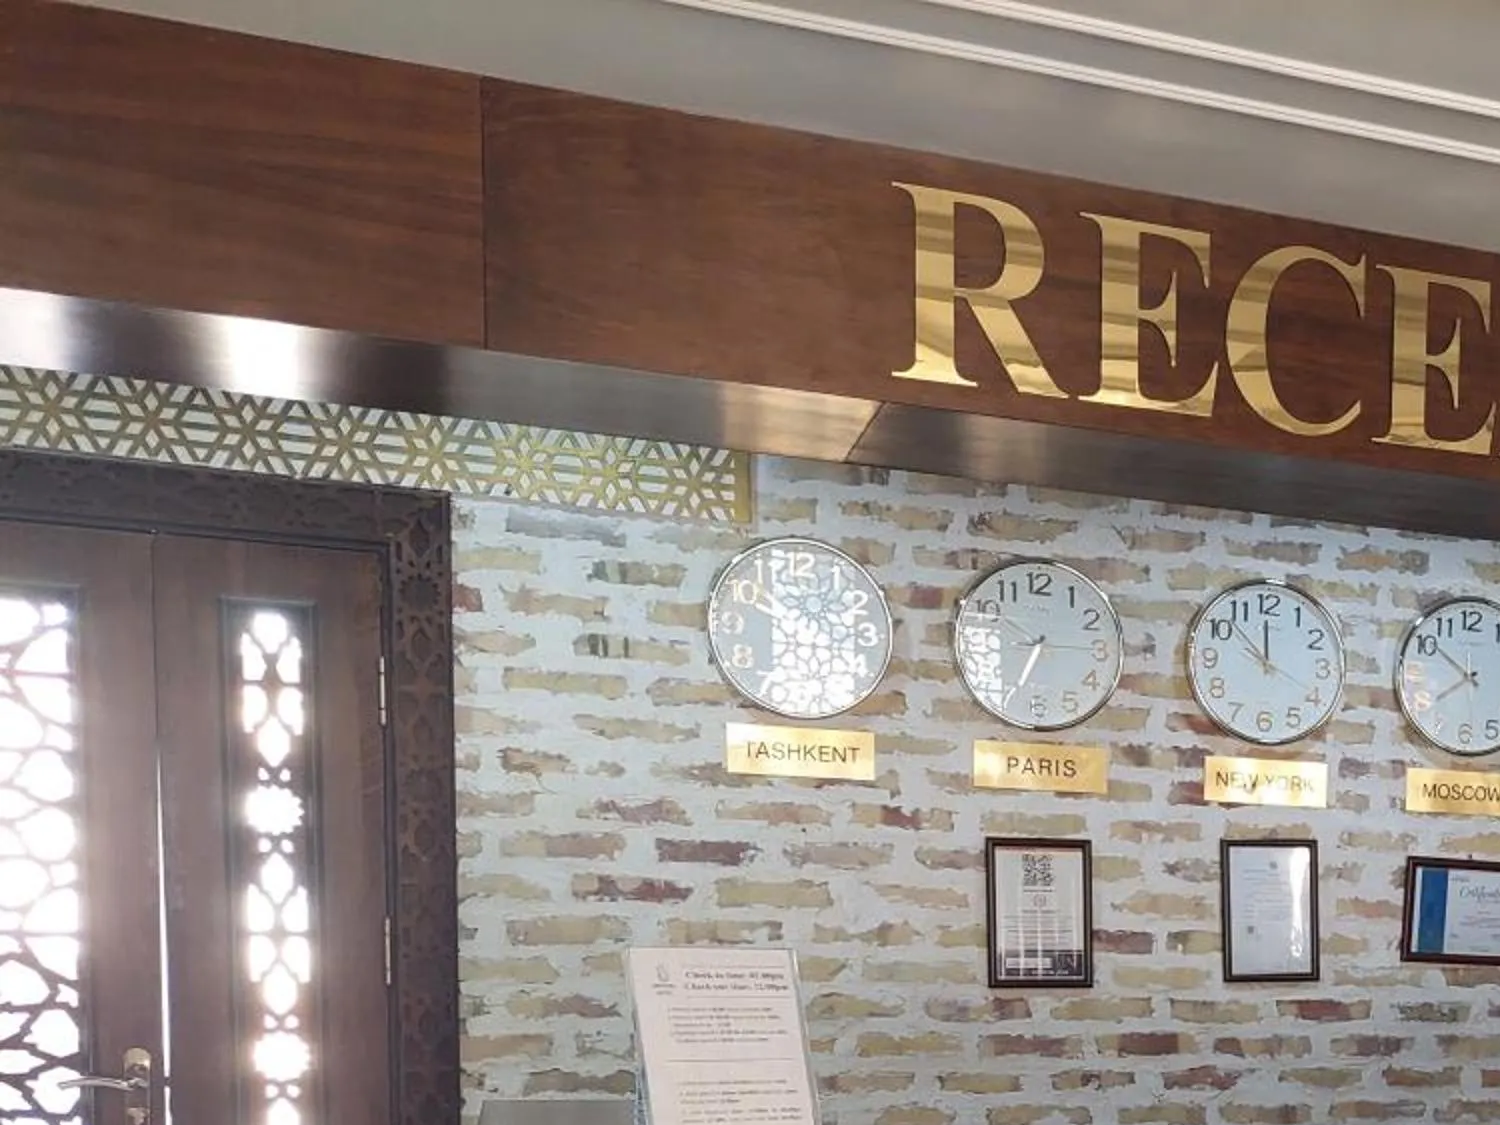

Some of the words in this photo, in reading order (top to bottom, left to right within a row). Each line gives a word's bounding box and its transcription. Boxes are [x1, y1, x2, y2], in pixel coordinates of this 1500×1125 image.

[785, 552, 816, 578] 12
[832, 565, 841, 590] 1
[1026, 571, 1052, 596] 12
[729, 579, 757, 604] 10
[998, 579, 1017, 603] 11
[1068, 585, 1075, 608] 1
[850, 590, 869, 615] 2
[976, 599, 1000, 622] 10
[1231, 601, 1248, 622] 11
[1258, 594, 1281, 617] 12
[721, 610, 744, 634] 9
[1083, 609, 1100, 631] 2
[1294, 606, 1301, 628] 1
[1436, 617, 1453, 638] 11
[1460, 611, 1483, 632] 12
[857, 622, 878, 647] 3
[1210, 618, 1233, 641] 10
[1308, 629, 1324, 650] 2
[1495, 623, 1500, 643] 1
[732, 645, 753, 668] 8
[1091, 640, 1110, 662] 3
[1416, 635, 1438, 656] 10
[1202, 647, 1219, 669] 9
[1315, 658, 1331, 680] 3
[1082, 670, 1100, 691] 4
[1210, 677, 1225, 698] 8
[1030, 695, 1047, 718] 6
[1062, 691, 1078, 713] 5
[1305, 686, 1321, 707] 4
[1228, 701, 1244, 723] 7
[1256, 711, 1274, 732] 6
[1286, 707, 1302, 729] 5
[1458, 724, 1473, 744] 6
[1484, 720, 1499, 740] 5
[747, 741, 860, 763] TASHKENT
[1006, 757, 1077, 778] PARIS
